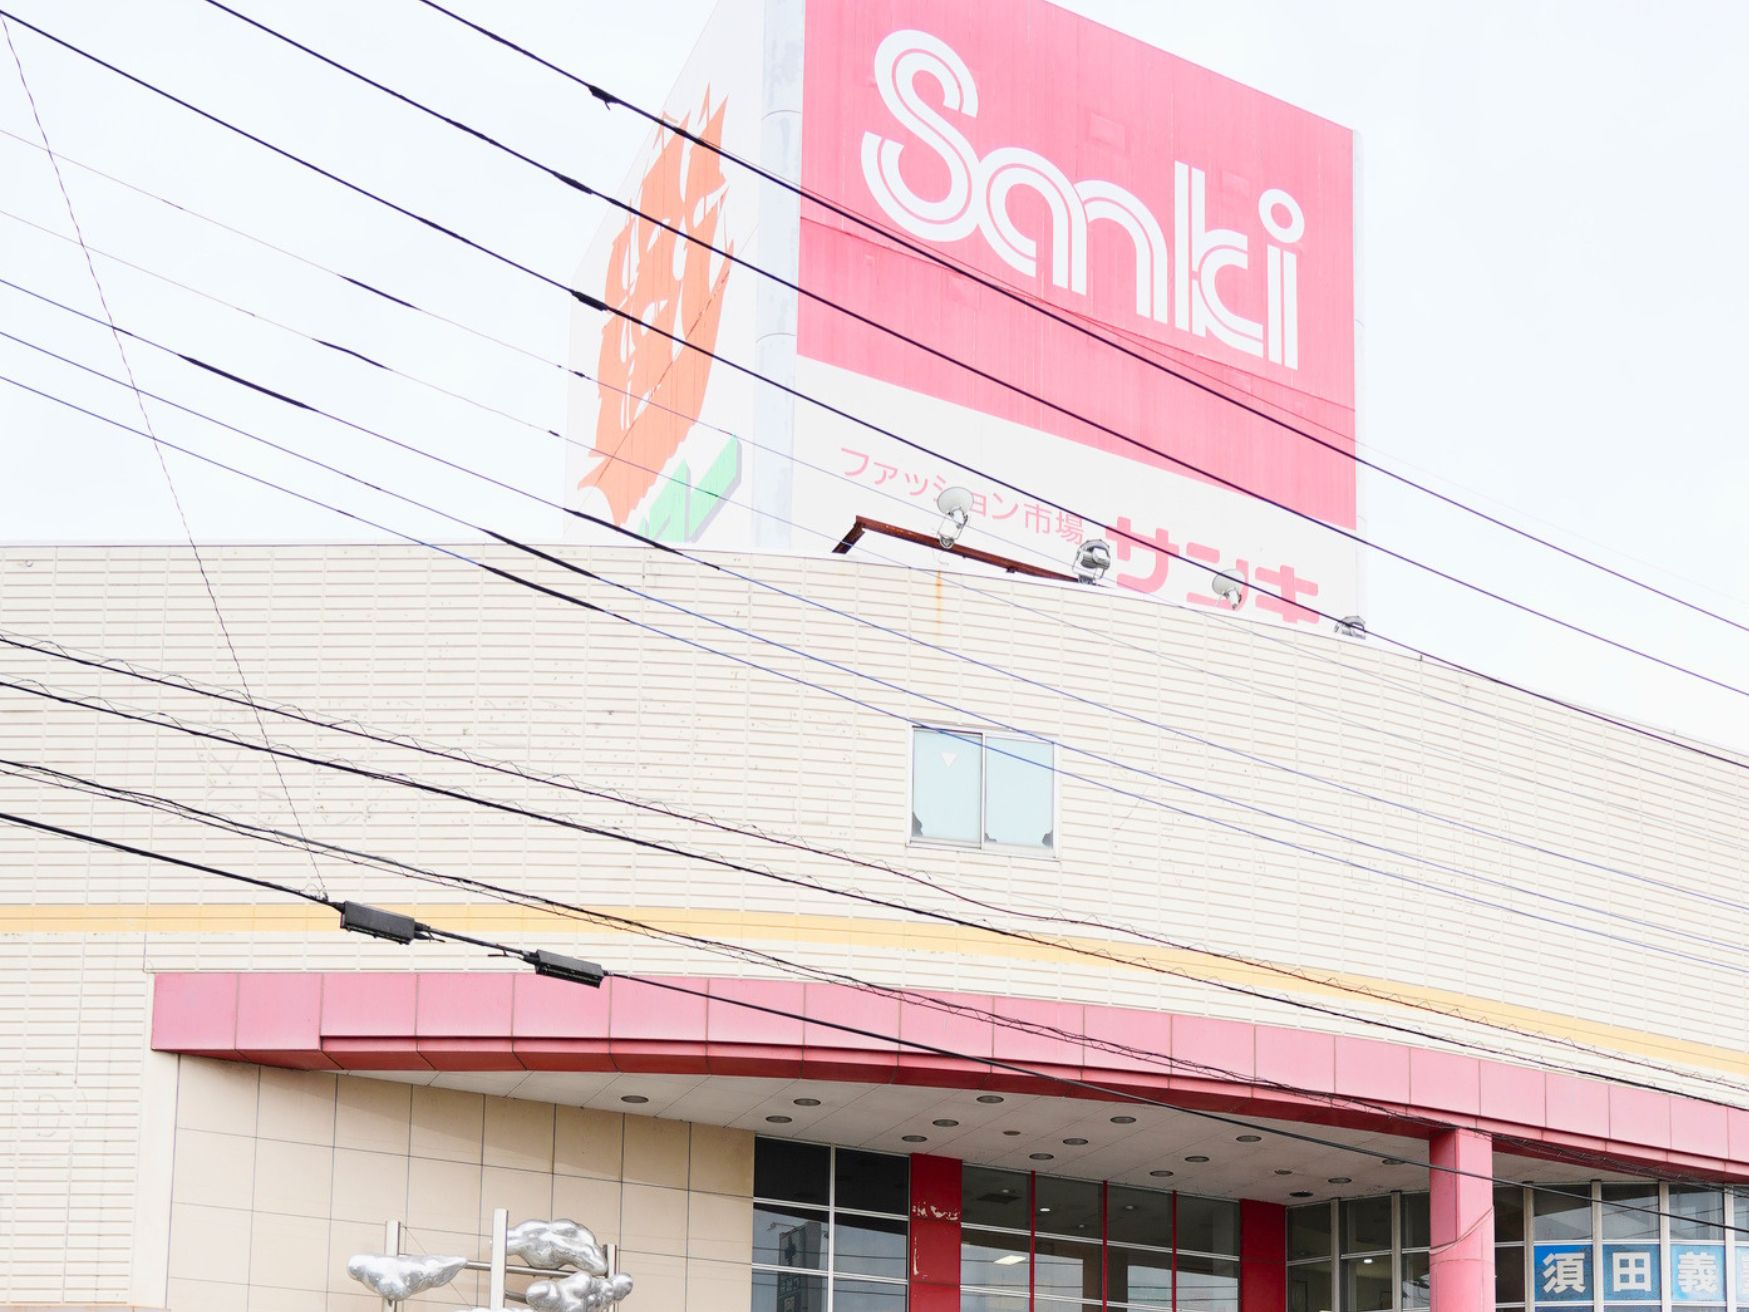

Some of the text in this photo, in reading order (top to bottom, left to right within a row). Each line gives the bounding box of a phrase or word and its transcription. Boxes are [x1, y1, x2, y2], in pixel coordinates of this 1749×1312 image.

[860, 28, 1305, 371] Sanki
[1105, 516, 1319, 624] サンキ
[1543, 1251, 1749, 1294] 須田義
